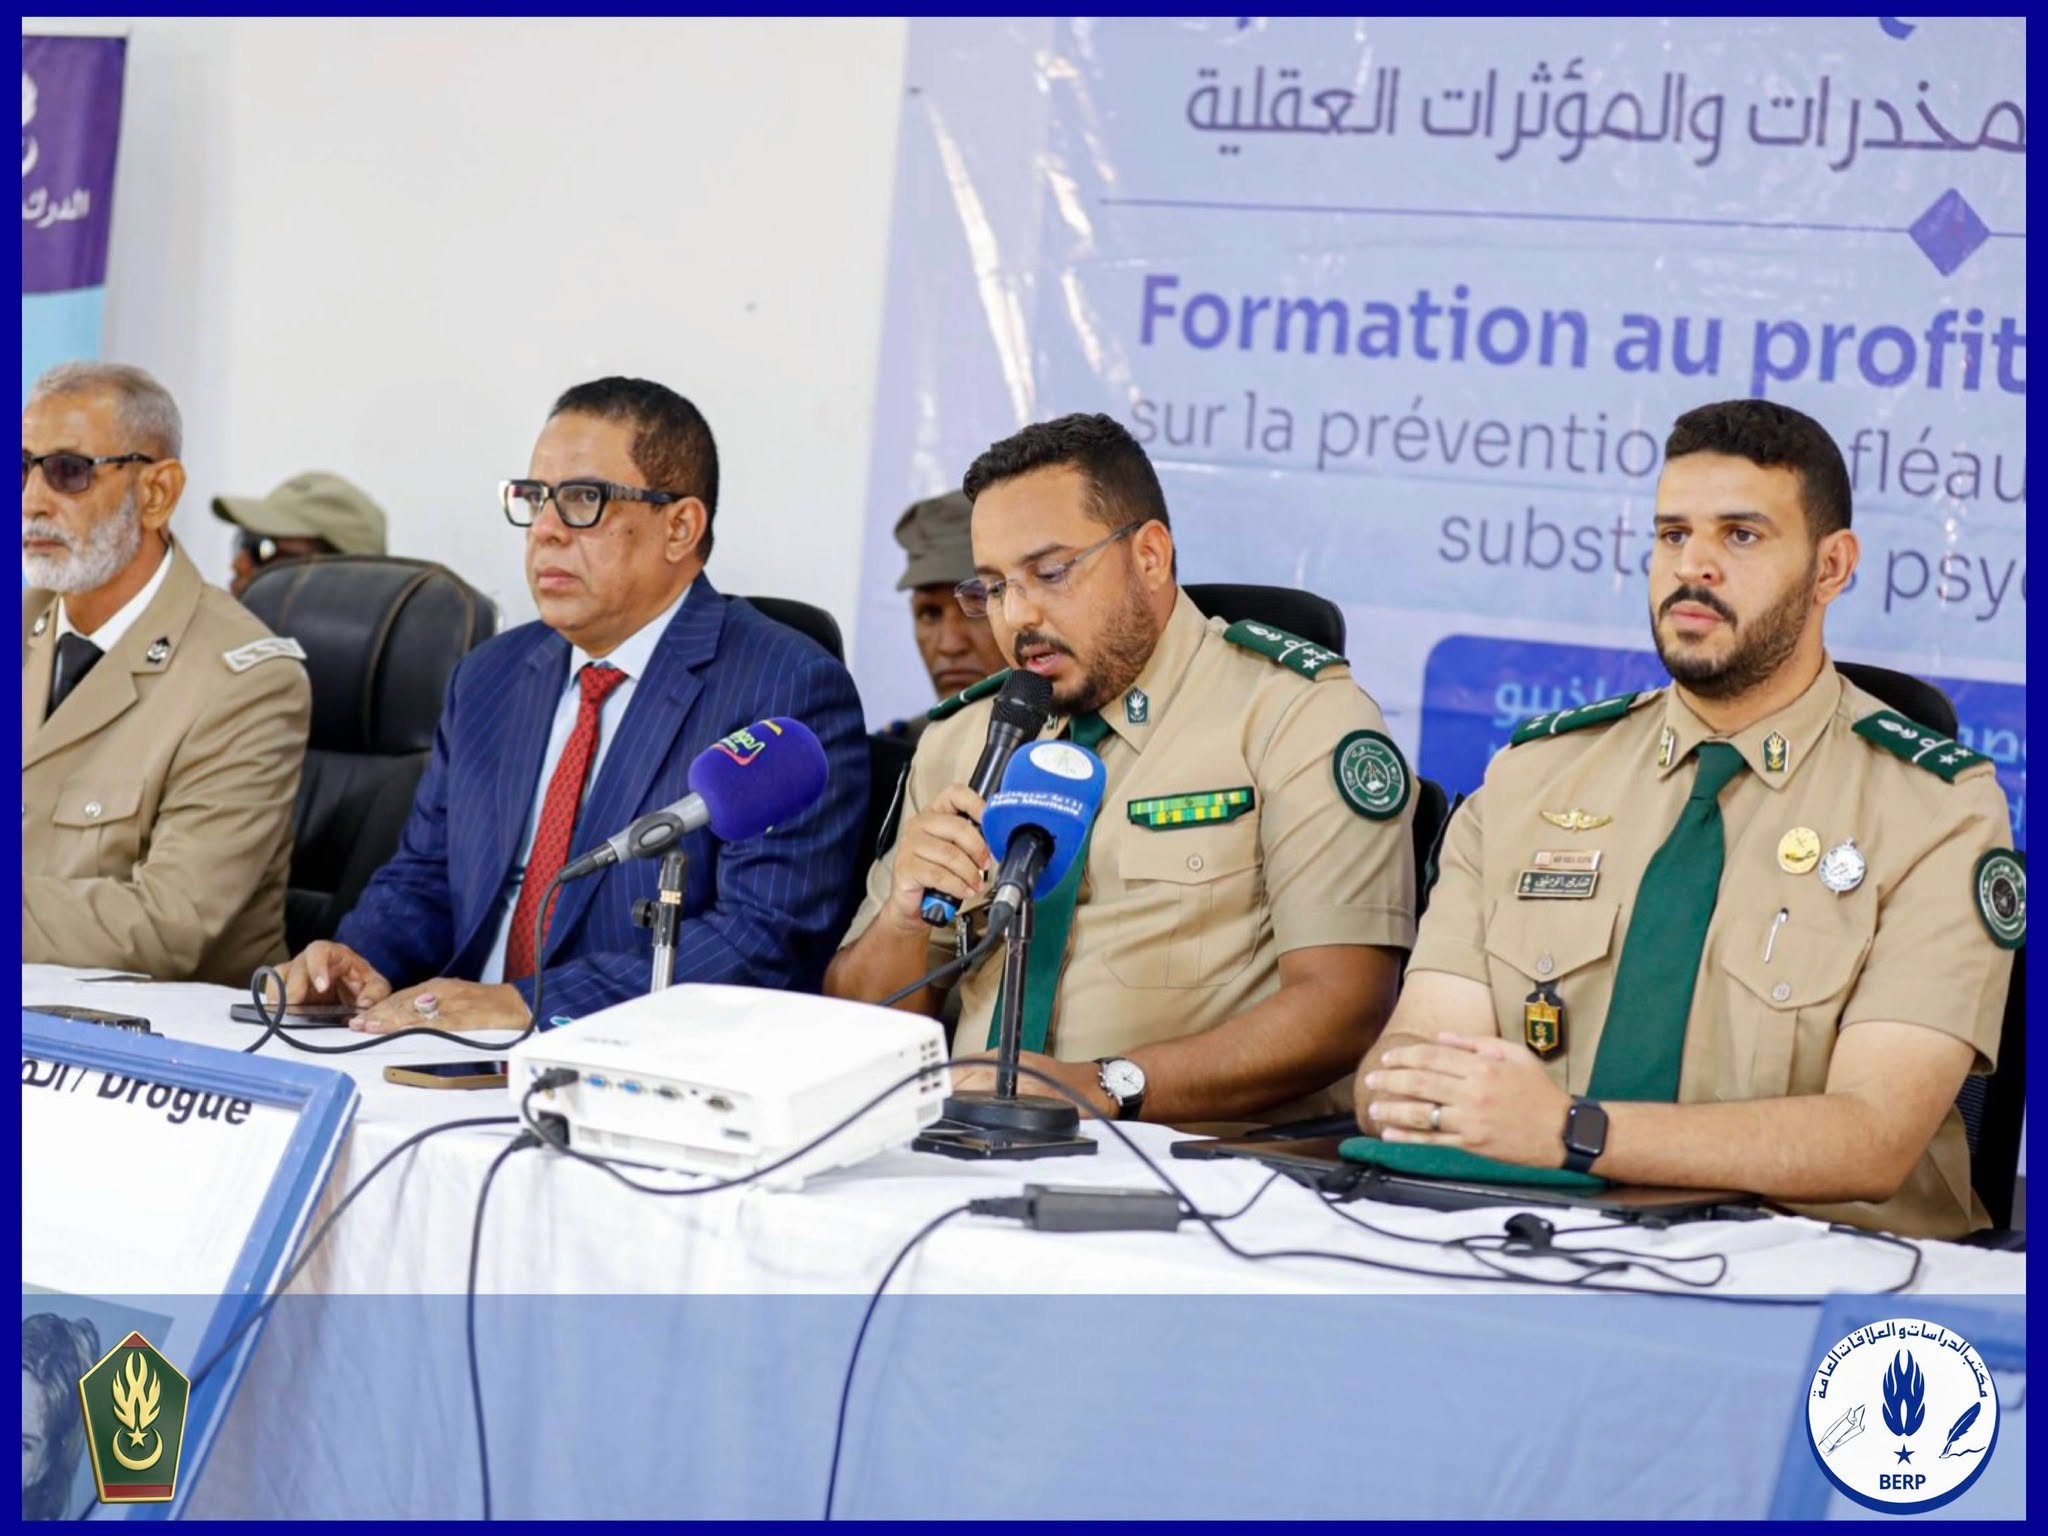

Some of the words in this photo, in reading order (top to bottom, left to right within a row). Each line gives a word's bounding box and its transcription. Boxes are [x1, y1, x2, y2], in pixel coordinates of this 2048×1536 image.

[1186, 66, 1400, 156] العقلية
[1420, 57, 1724, 168] والمؤثرات
[1138, 273, 1589, 370] Formation
[1613, 313, 1723, 377] au
[1750, 307, 2027, 399] profit
[1129, 398, 1226, 447] sur
[1243, 391, 1294, 452] la
[1315, 394, 1659, 478] préventio
[1883, 548, 2027, 622] psy
[97, 1070, 253, 1125] Drogue
